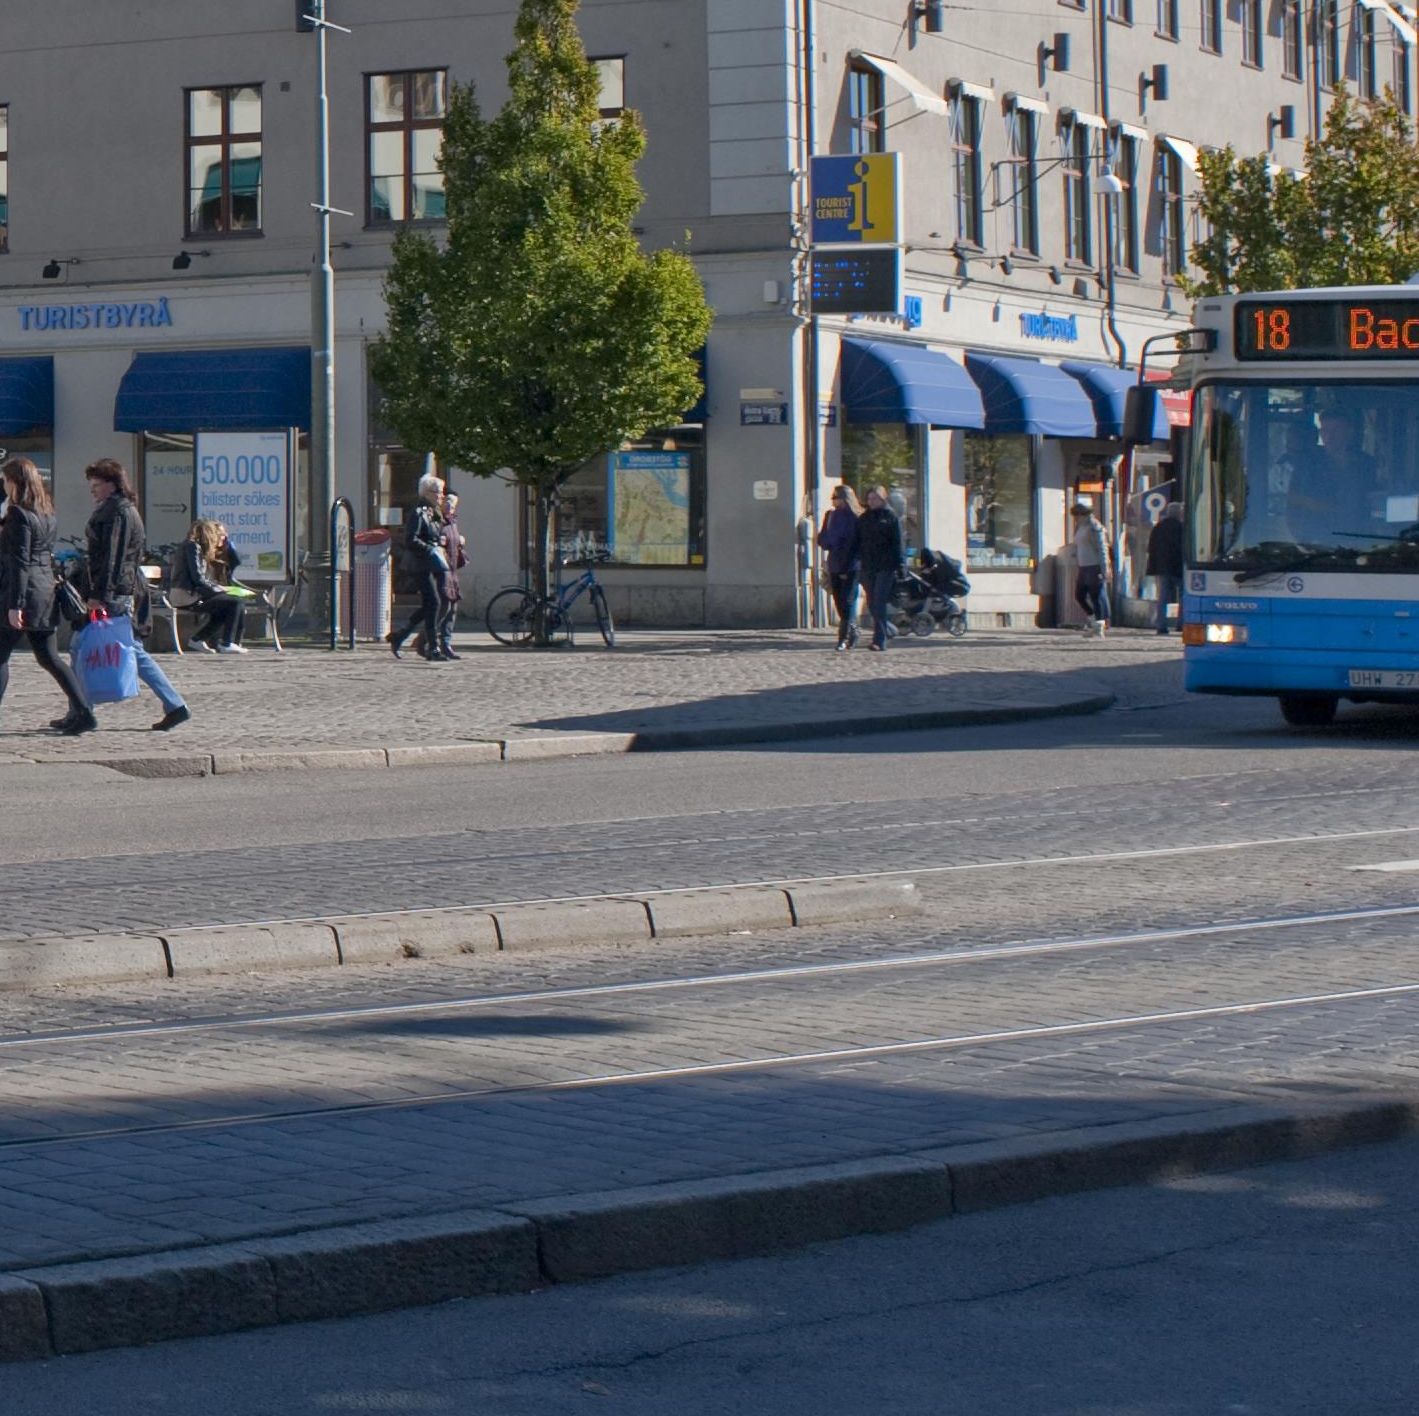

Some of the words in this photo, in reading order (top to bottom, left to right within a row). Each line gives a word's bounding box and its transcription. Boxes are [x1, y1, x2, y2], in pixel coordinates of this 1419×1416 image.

[816, 197, 852, 208] TOURIST
[816, 209, 848, 219] CENTRE
[18, 296, 172, 330] TURISTBYRÅ
[1254, 309, 1290, 351] 18
[201, 455, 281, 484] 50.000
[202, 491, 242, 506] bilister
[244, 490, 281, 506] sökes
[238, 511, 268, 526] stort
[1214, 601, 1259, 610] VOLVO
[1395, 673, 1419, 686] 27
